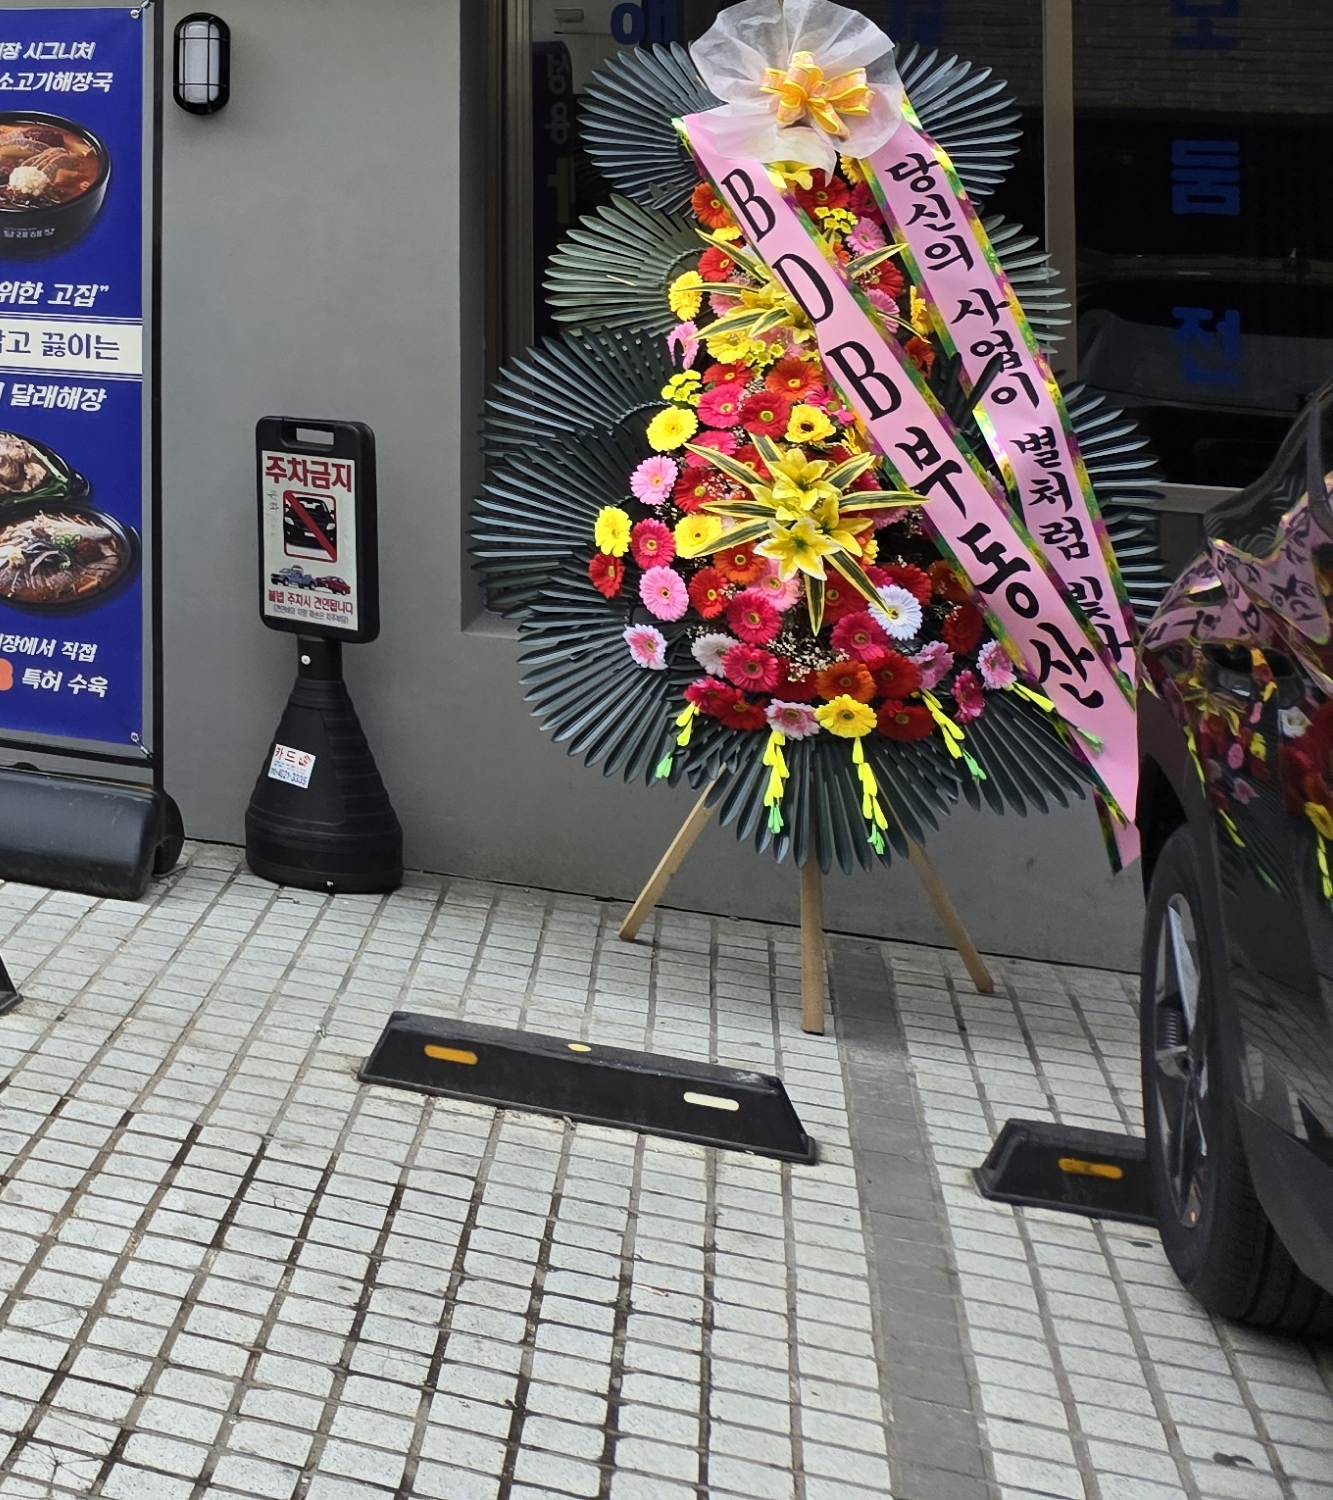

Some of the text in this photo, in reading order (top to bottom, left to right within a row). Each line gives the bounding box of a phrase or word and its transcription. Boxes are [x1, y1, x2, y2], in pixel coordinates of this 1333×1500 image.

[23, 41, 95, 60] 시그니처
[41, 331, 120, 361] 끓이는
[884, 152, 974, 275] 당신의
[1010, 426, 1091, 562] 별처럼
[11, 383, 106, 412] 달래해장
[265, 455, 352, 492] 주차금지
[61, 638, 99, 662] 직접
[21, 668, 61, 692] 특허
[67, 672, 109, 697] 수육
